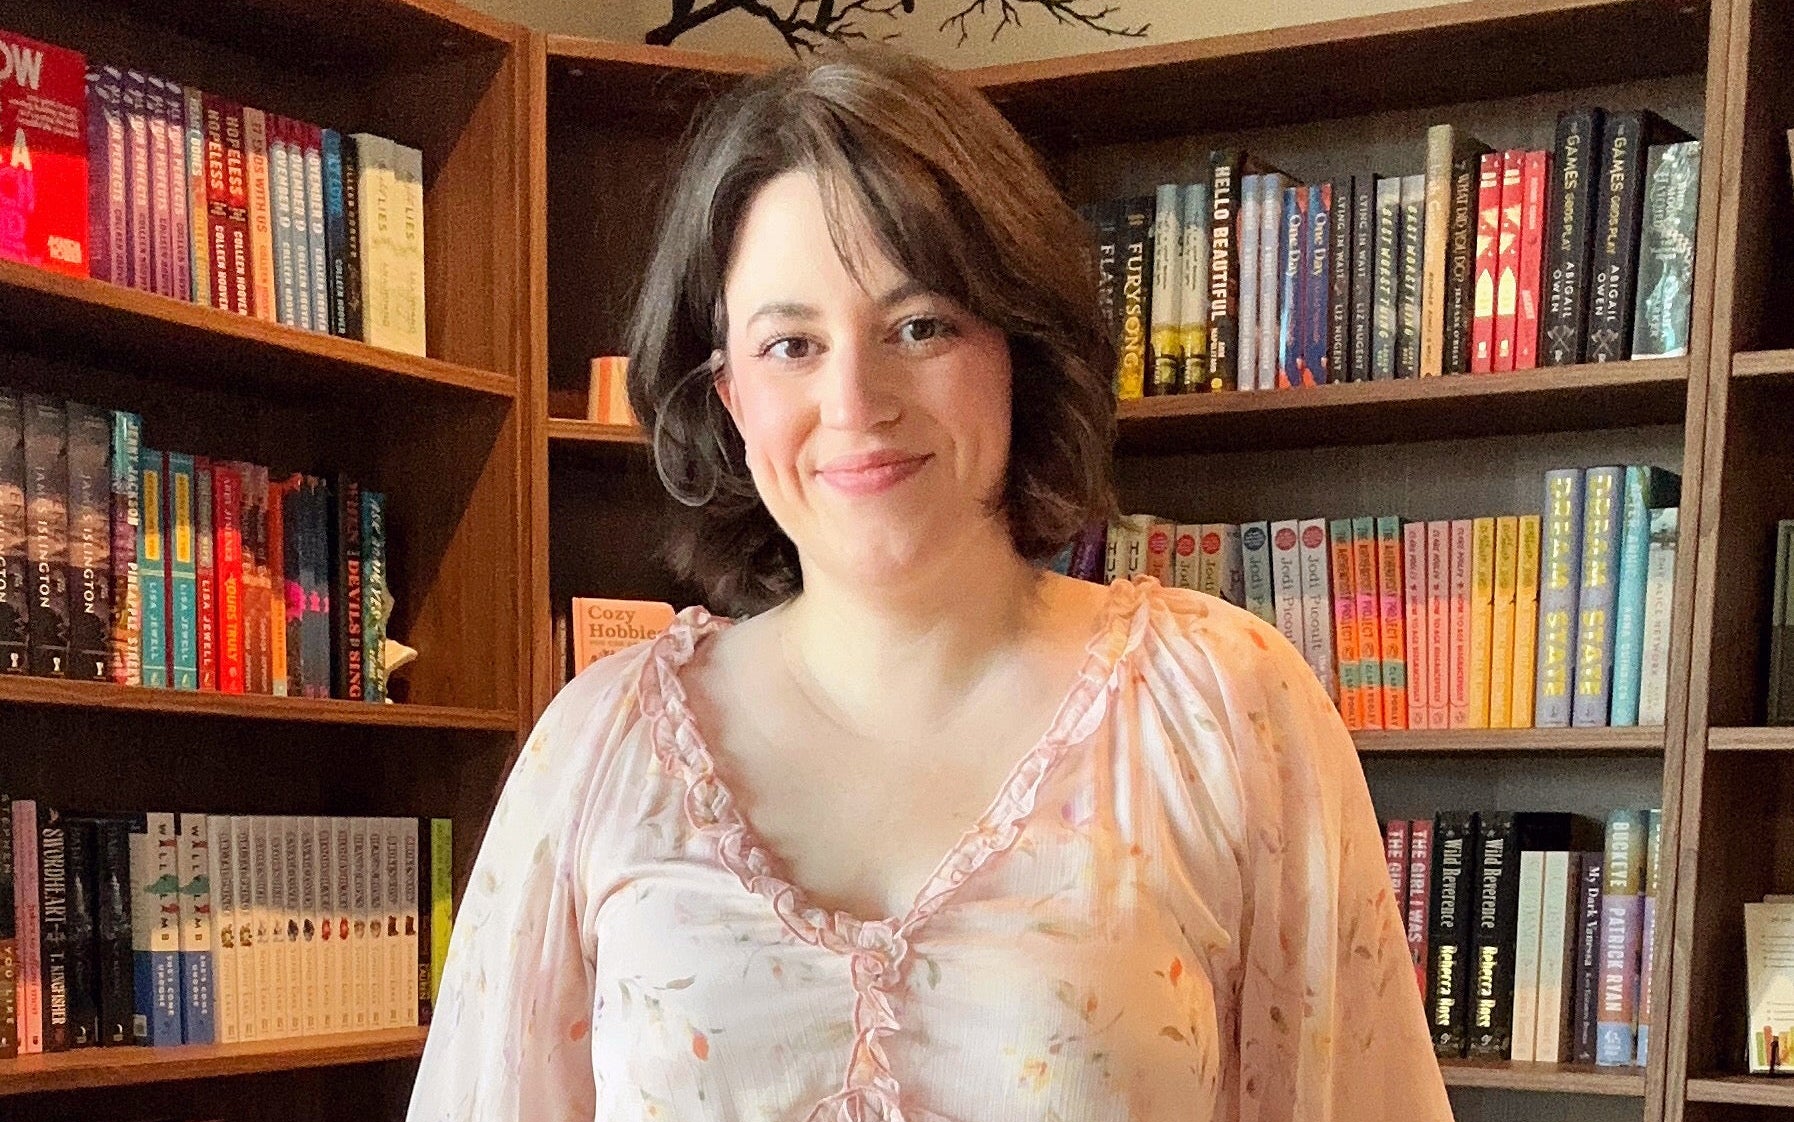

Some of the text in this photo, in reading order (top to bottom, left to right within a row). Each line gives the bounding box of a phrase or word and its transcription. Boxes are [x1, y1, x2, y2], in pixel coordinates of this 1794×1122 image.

[112, 143, 122, 202] PERFECTS
[136, 148, 146, 205] PERFECTS
[191, 137, 202, 176] BONES
[207, 110, 224, 189] HOPELESS
[226, 117, 242, 195] HOPELESS
[1563, 135, 1580, 190] GAMES
[1610, 136, 1626, 192] GAMES
[174, 159, 184, 216] PERFECTS
[256, 178, 267, 233] WITH US
[1211, 166, 1231, 321] HELLO BEAUTIFUL
[1285, 214, 1301, 278] One Day
[1312, 213, 1326, 277] One Day
[1453, 173, 1470, 283] WHAT DID YOU DO?
[215, 225, 228, 311] COLLEEN HOOVER
[233, 231, 248, 316] COLLEEN HOOVER
[1379, 208, 1392, 339] BEST WORST THING
[1404, 205, 1417, 336] BEST WORST THING
[1551, 270, 1562, 313] OWEN
[1563, 262, 1575, 318] ABIGAIL
[1595, 273, 1606, 316] OWEN
[1607, 265, 1620, 322] ABIGAIL
[1124, 242, 1143, 368] FURYSONG
[127, 466, 140, 525] JACKSON
[38, 520, 50, 608] ISLINGTON
[83, 528, 95, 614] ISLINGTON
[127, 562, 139, 630] PINEAPPLE
[1251, 556, 1263, 590] Jodi
[226, 576, 237, 661] YOURS TRULY
[348, 560, 361, 698] DEVILS SING
[588, 605, 636, 624] Cozy
[1281, 557, 1297, 645] Jodi Picou
[1308, 555, 1322, 651] Jodi Picoult
[1361, 600, 1373, 638] PROJECT
[1384, 601, 1396, 639] PROJECT
[1651, 621, 1662, 676] NETWORK
[1, 794, 11, 874] STEPHEN
[1388, 831, 1403, 859] THE
[1411, 830, 1427, 859] THE
[1610, 822, 1629, 887] BUCKEYE
[42, 829, 66, 924] SWORDHEART
[1409, 863, 1426, 898] GIRL
[1440, 839, 1463, 929] Wild Reverence
[1481, 838, 1504, 929] Wild Reverence
[1408, 907, 1424, 943] WAS
[1584, 865, 1600, 967] My Dark Vanessa
[1435, 945, 1457, 1027] Rebecca Ross
[1476, 945, 1498, 1028] Rebecca Ross
[1605, 908, 1626, 1012] PATRICK RYAN
[51, 965, 66, 1025] KINGFISHER
